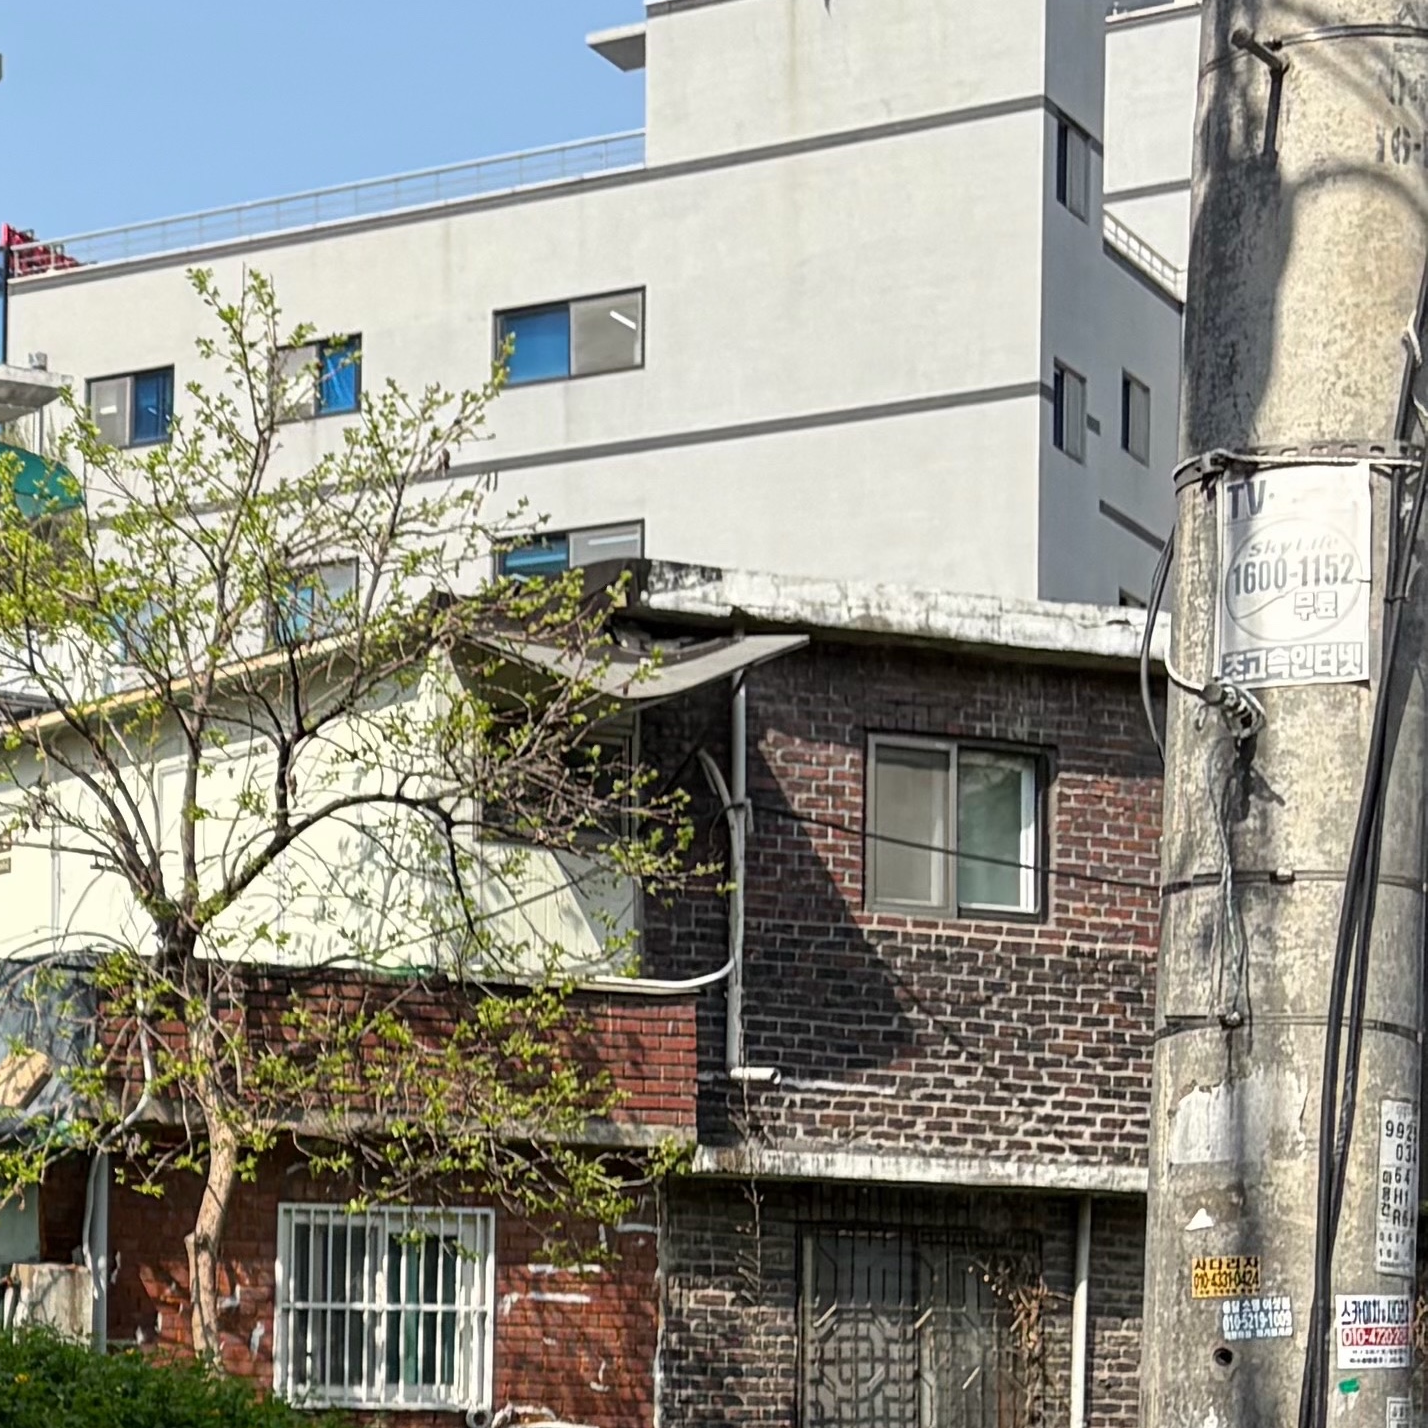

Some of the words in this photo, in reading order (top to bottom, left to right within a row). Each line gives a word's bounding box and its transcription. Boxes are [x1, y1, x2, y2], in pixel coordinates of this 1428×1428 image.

[1227, 480, 1266, 519] TV
[1232, 553, 1355, 596] 1600-1152
[1294, 591, 1338, 621] 무료
